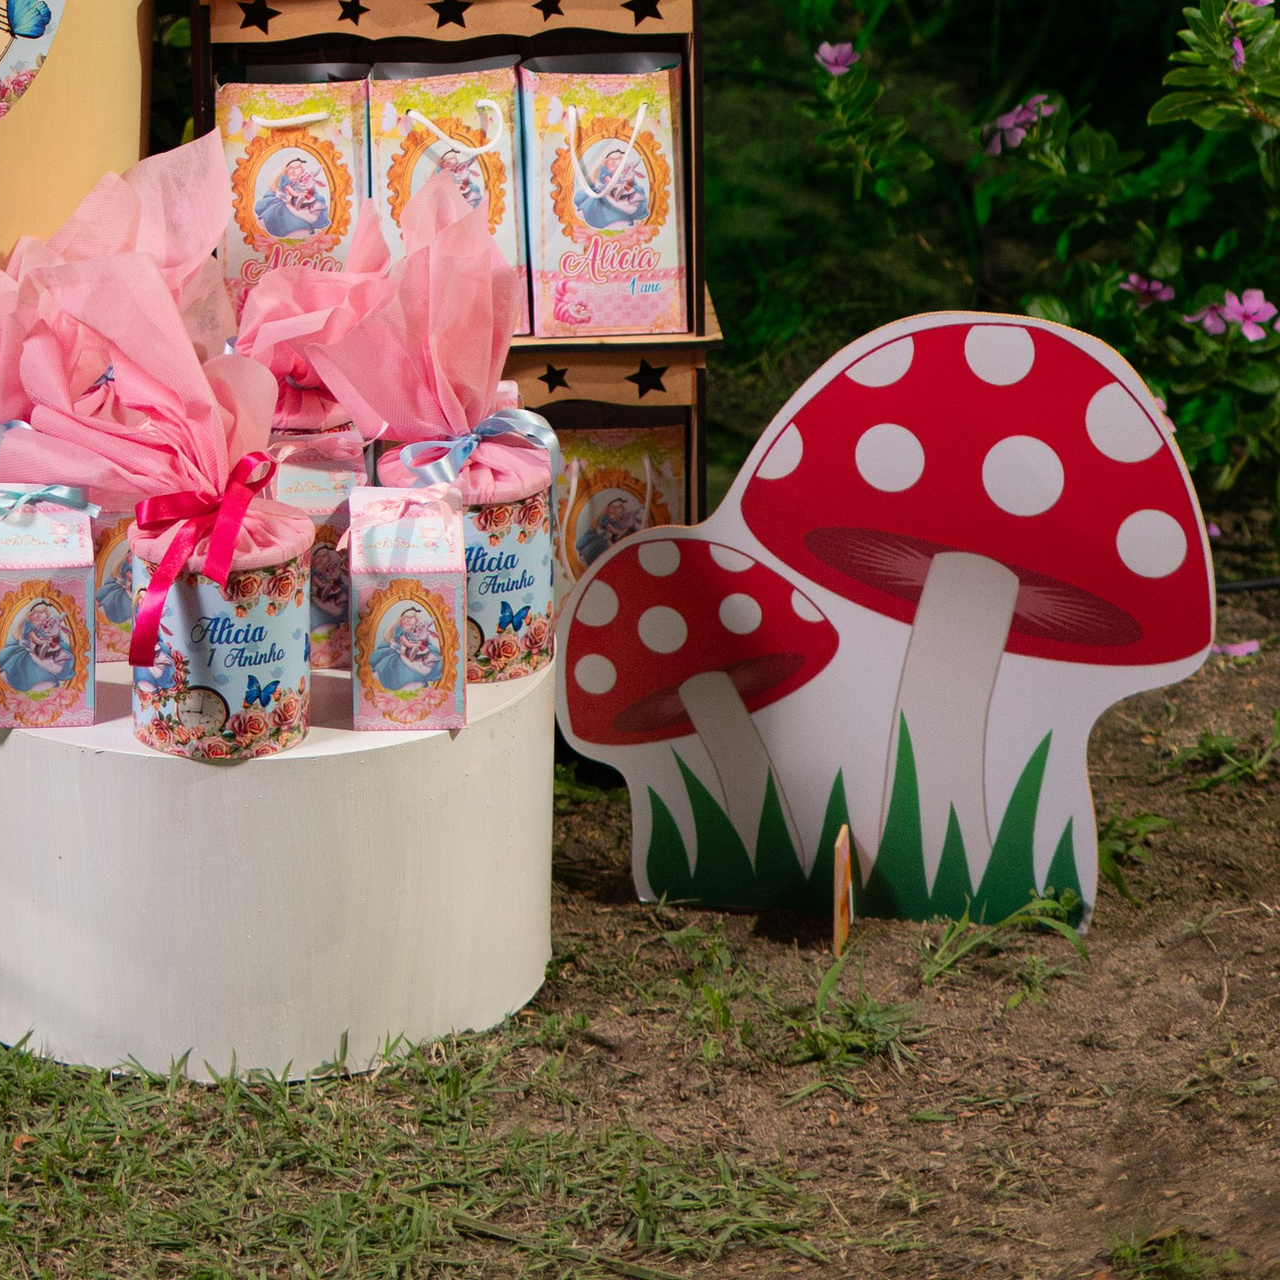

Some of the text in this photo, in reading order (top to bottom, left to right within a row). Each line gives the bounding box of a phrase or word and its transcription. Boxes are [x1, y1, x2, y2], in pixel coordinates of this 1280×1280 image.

[561, 236, 660, 283] Alícia
[478, 569, 535, 595] Aninho
[207, 642, 286, 668] 1 Aninho
